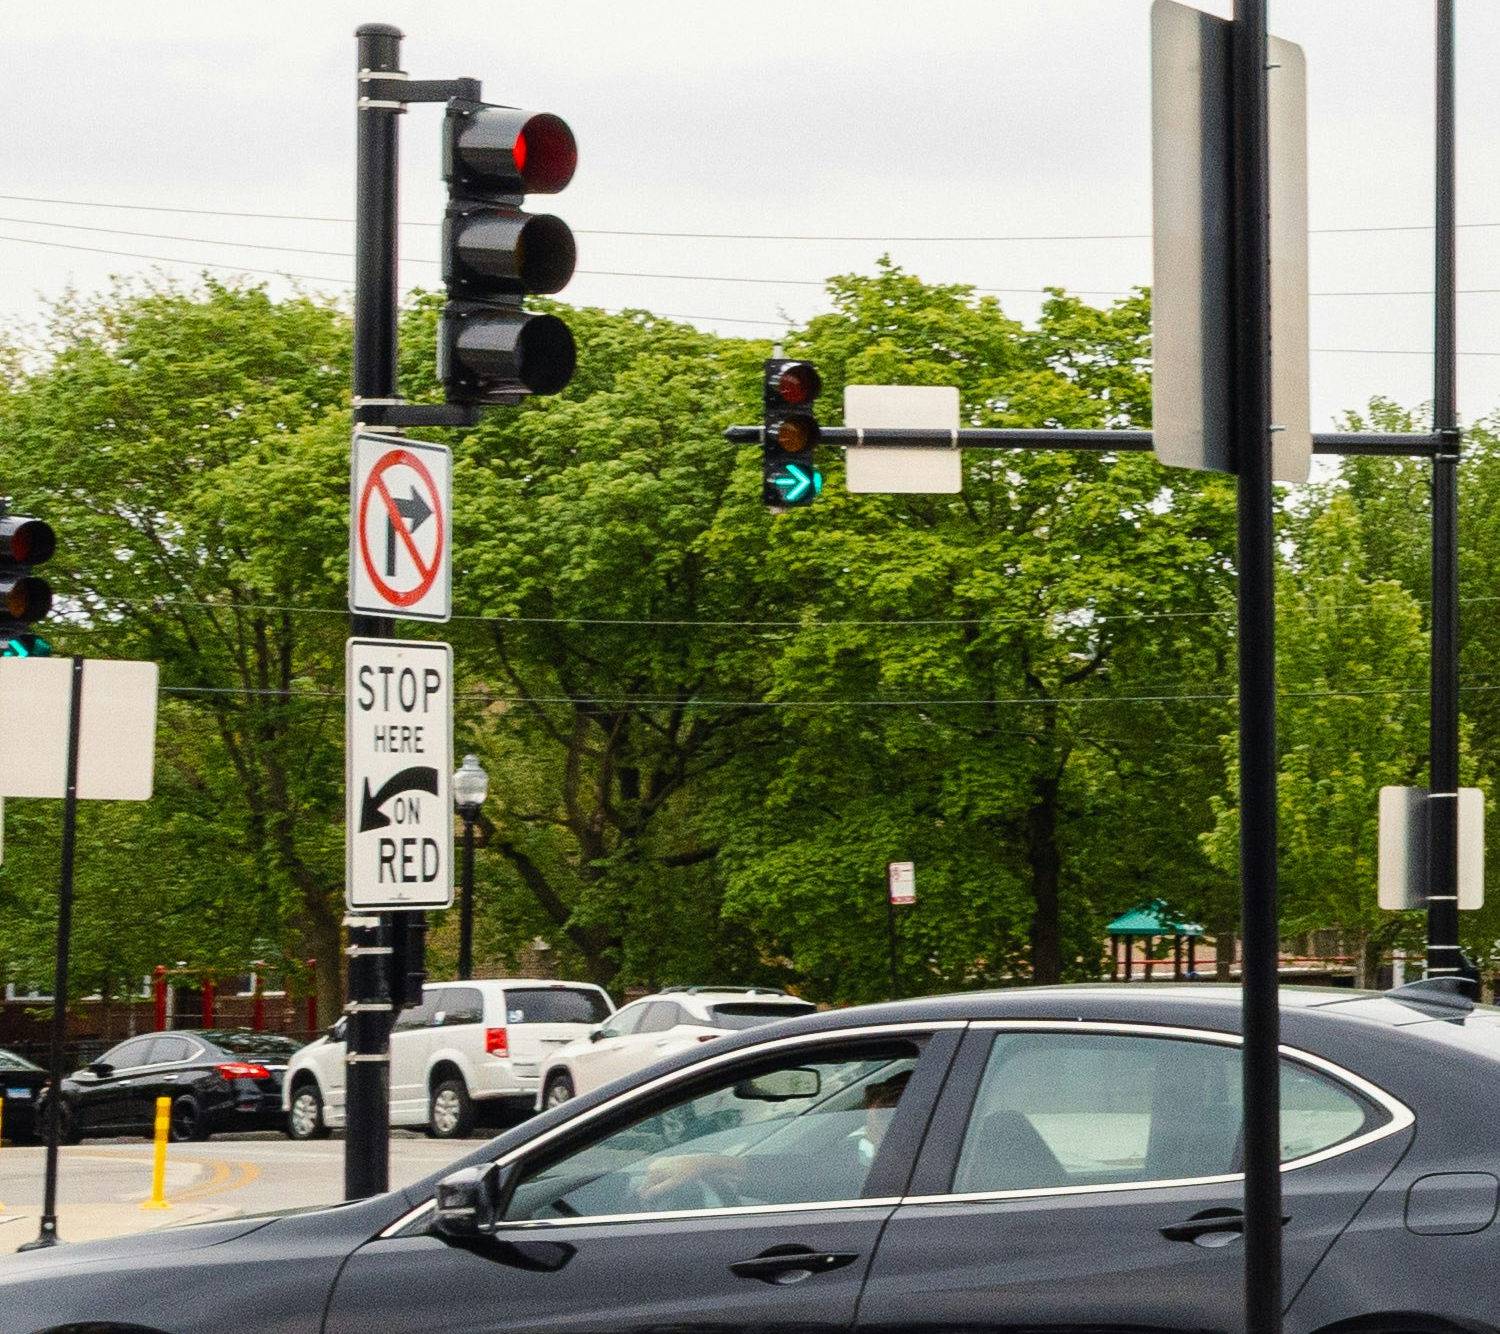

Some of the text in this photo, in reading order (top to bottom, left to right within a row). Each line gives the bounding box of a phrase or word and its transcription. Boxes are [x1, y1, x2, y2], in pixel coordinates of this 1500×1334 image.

[358, 665, 441, 714] STOP
[373, 725, 425, 754] HERE
[393, 796, 421, 825] ON
[378, 837, 440, 884] RED
